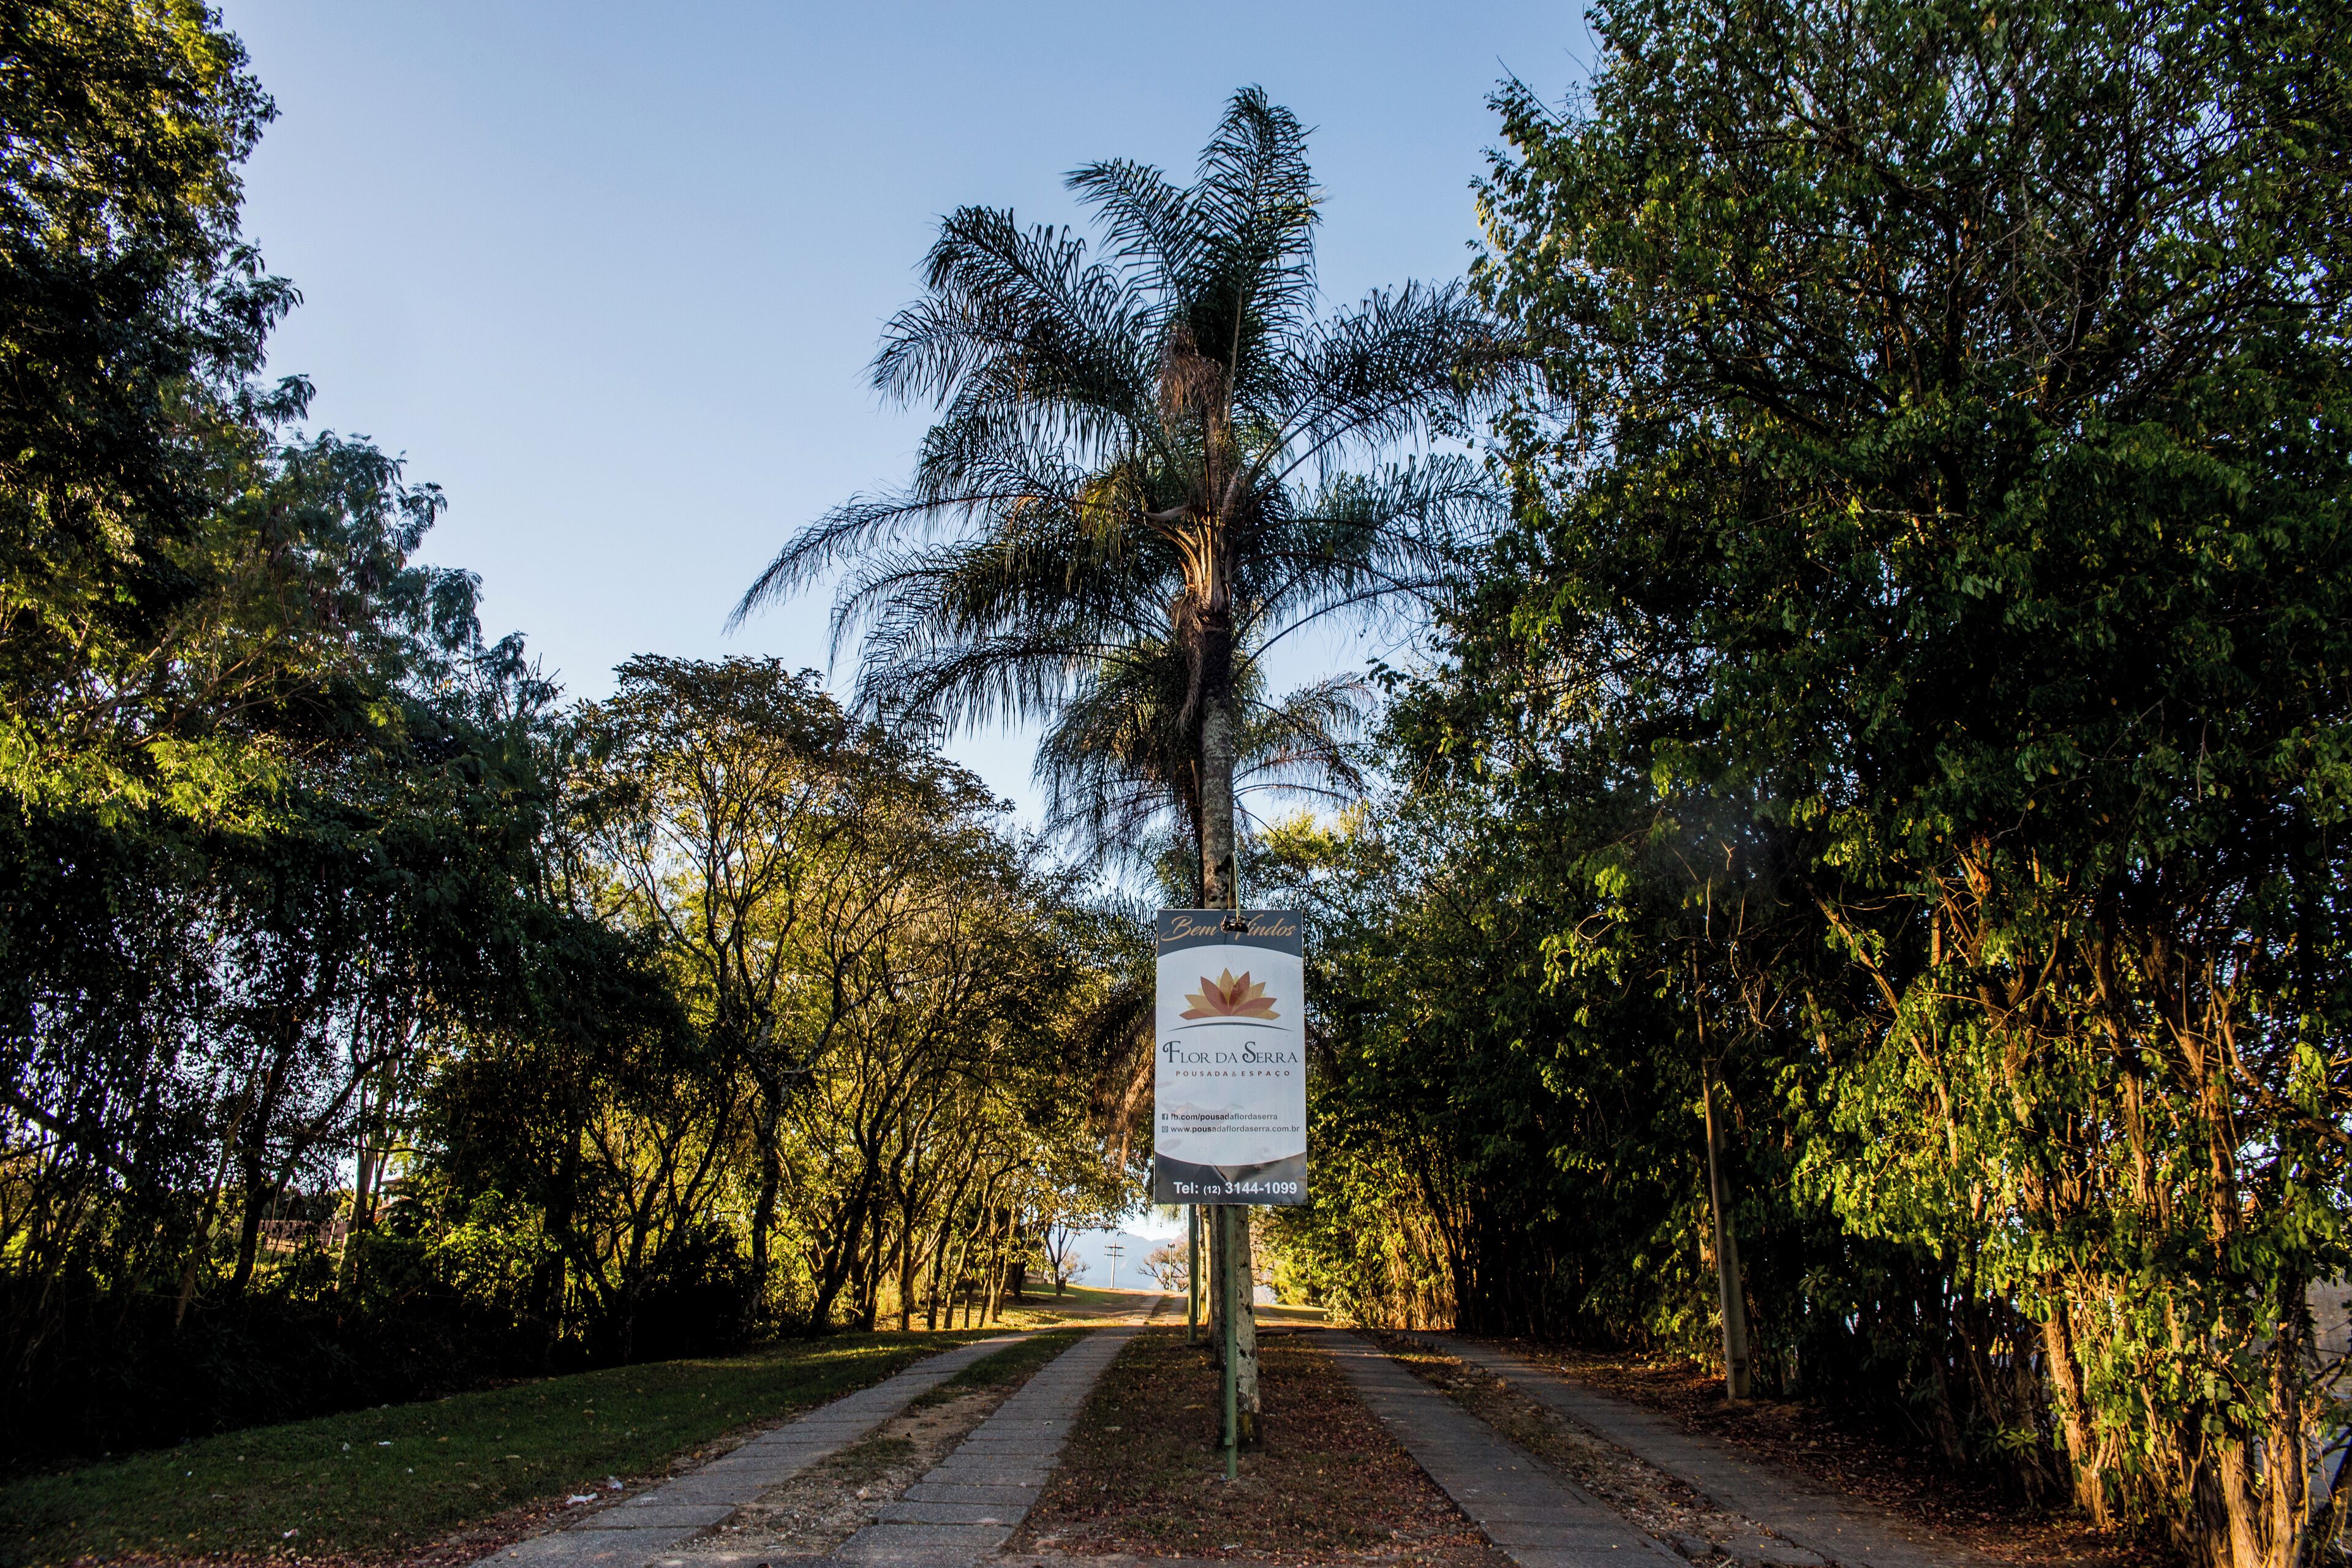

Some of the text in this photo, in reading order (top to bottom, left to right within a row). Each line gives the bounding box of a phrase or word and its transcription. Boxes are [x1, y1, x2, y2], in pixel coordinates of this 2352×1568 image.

[1161, 915, 1218, 941] Bem
[1170, 1113, 1278, 1121] fb.com/pousadaflordaserra
[1170, 1125, 1300, 1134] www.pousadaflordaserra.com.br
[1173, 1182, 1298, 1196] Tel: (12) 3144-1099
